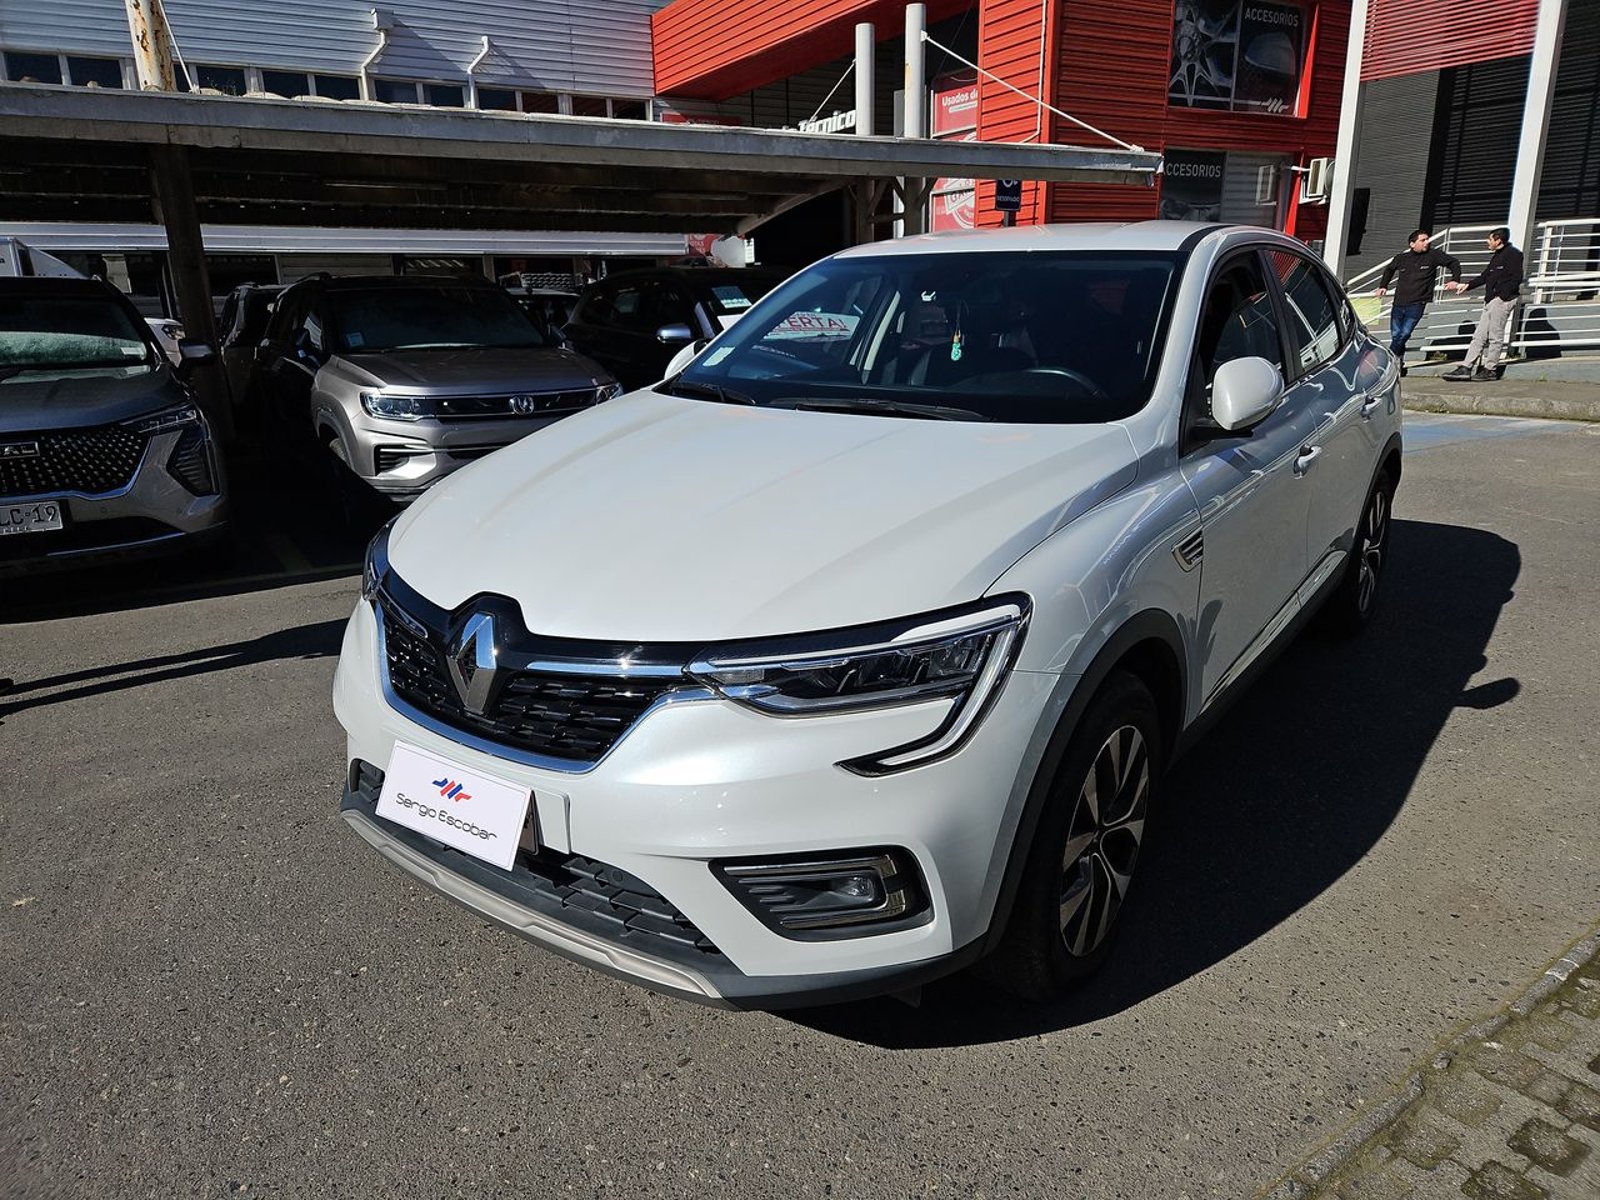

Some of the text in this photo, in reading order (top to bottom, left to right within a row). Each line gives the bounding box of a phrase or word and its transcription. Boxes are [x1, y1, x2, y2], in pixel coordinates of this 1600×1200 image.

[1244, 7, 1299, 27] ACCESORIOS
[941, 92, 969, 107] Usados
[969, 88, 978, 100] d
[1164, 162, 1221, 178] CCESORIOS
[783, 316, 848, 330] ERTA!
[438, 809, 498, 841] Escobar
